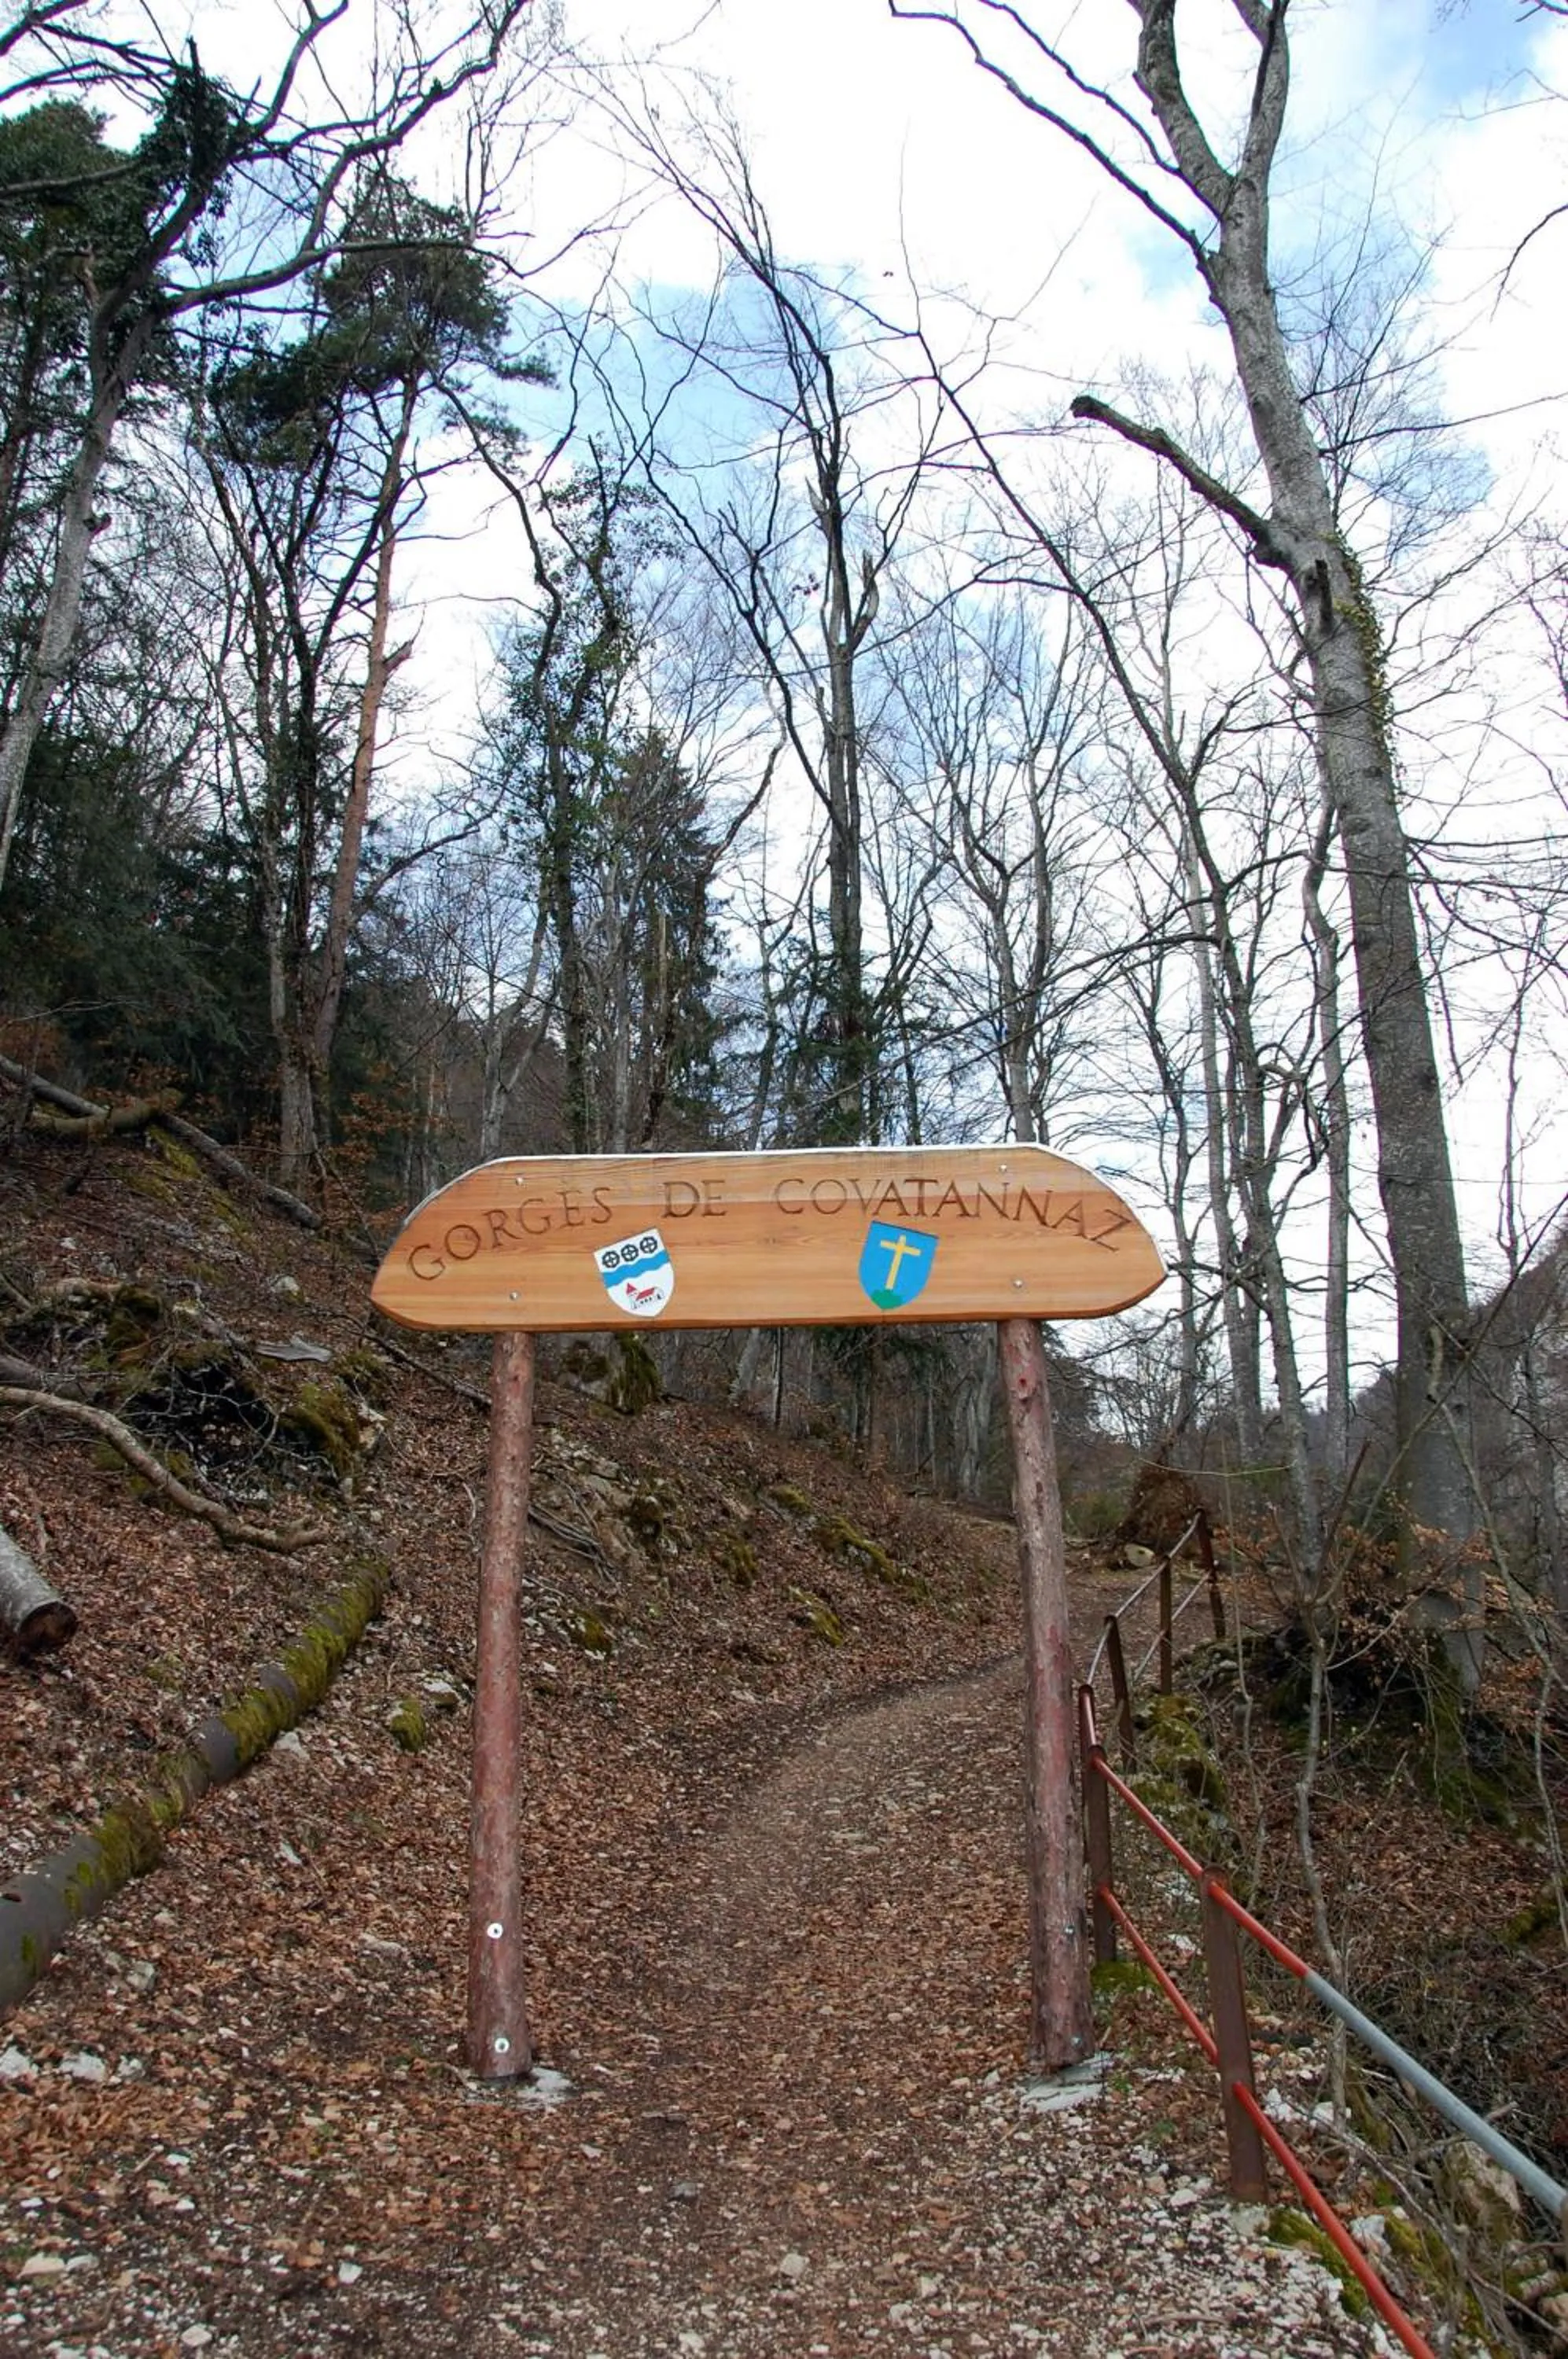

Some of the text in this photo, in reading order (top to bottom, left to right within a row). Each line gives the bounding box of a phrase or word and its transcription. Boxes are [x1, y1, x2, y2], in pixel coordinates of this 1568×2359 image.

[407, 1179, 1131, 1281] GORGES DE COVATANNAZ
